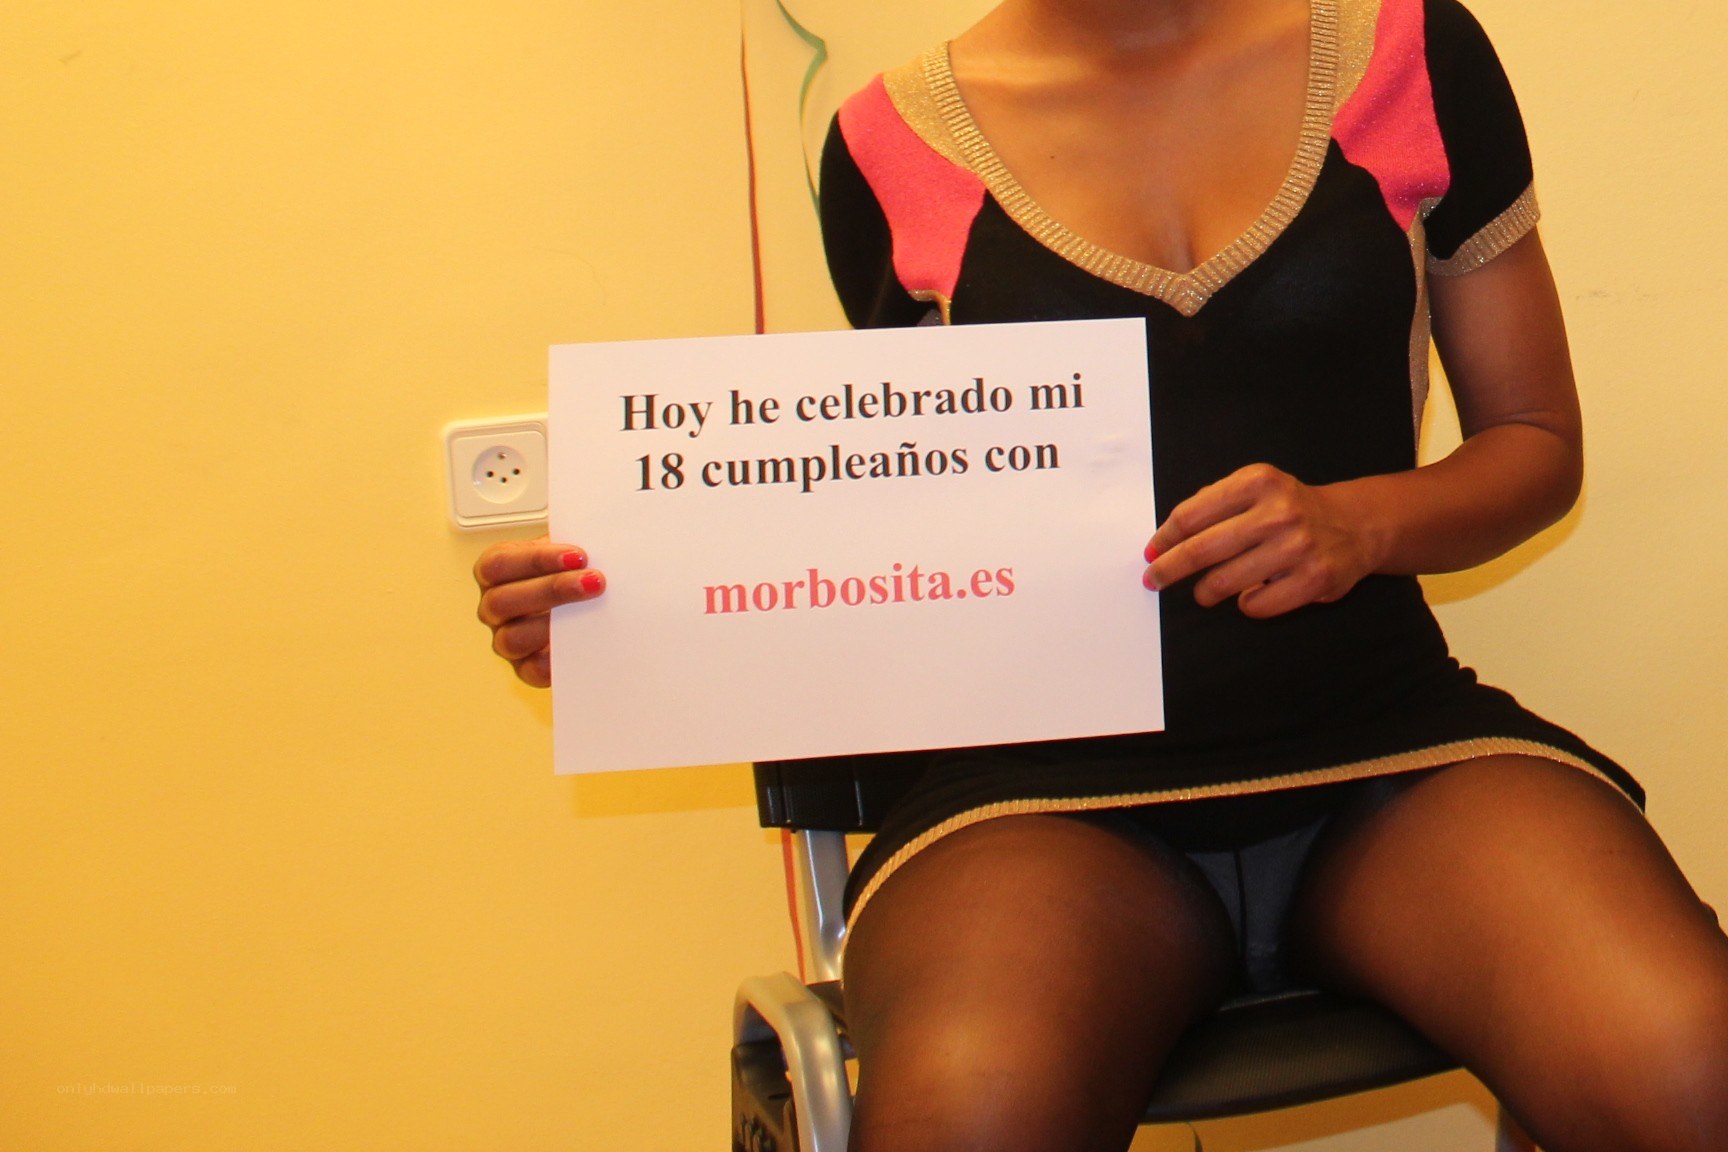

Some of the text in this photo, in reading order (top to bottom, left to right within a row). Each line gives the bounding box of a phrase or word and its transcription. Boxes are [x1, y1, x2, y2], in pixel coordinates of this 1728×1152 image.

[619, 372, 1086, 438] Hoy he celebrado mi
[635, 441, 1061, 493] 18 cumpleaños con
[702, 562, 1016, 615] morbosita.es
